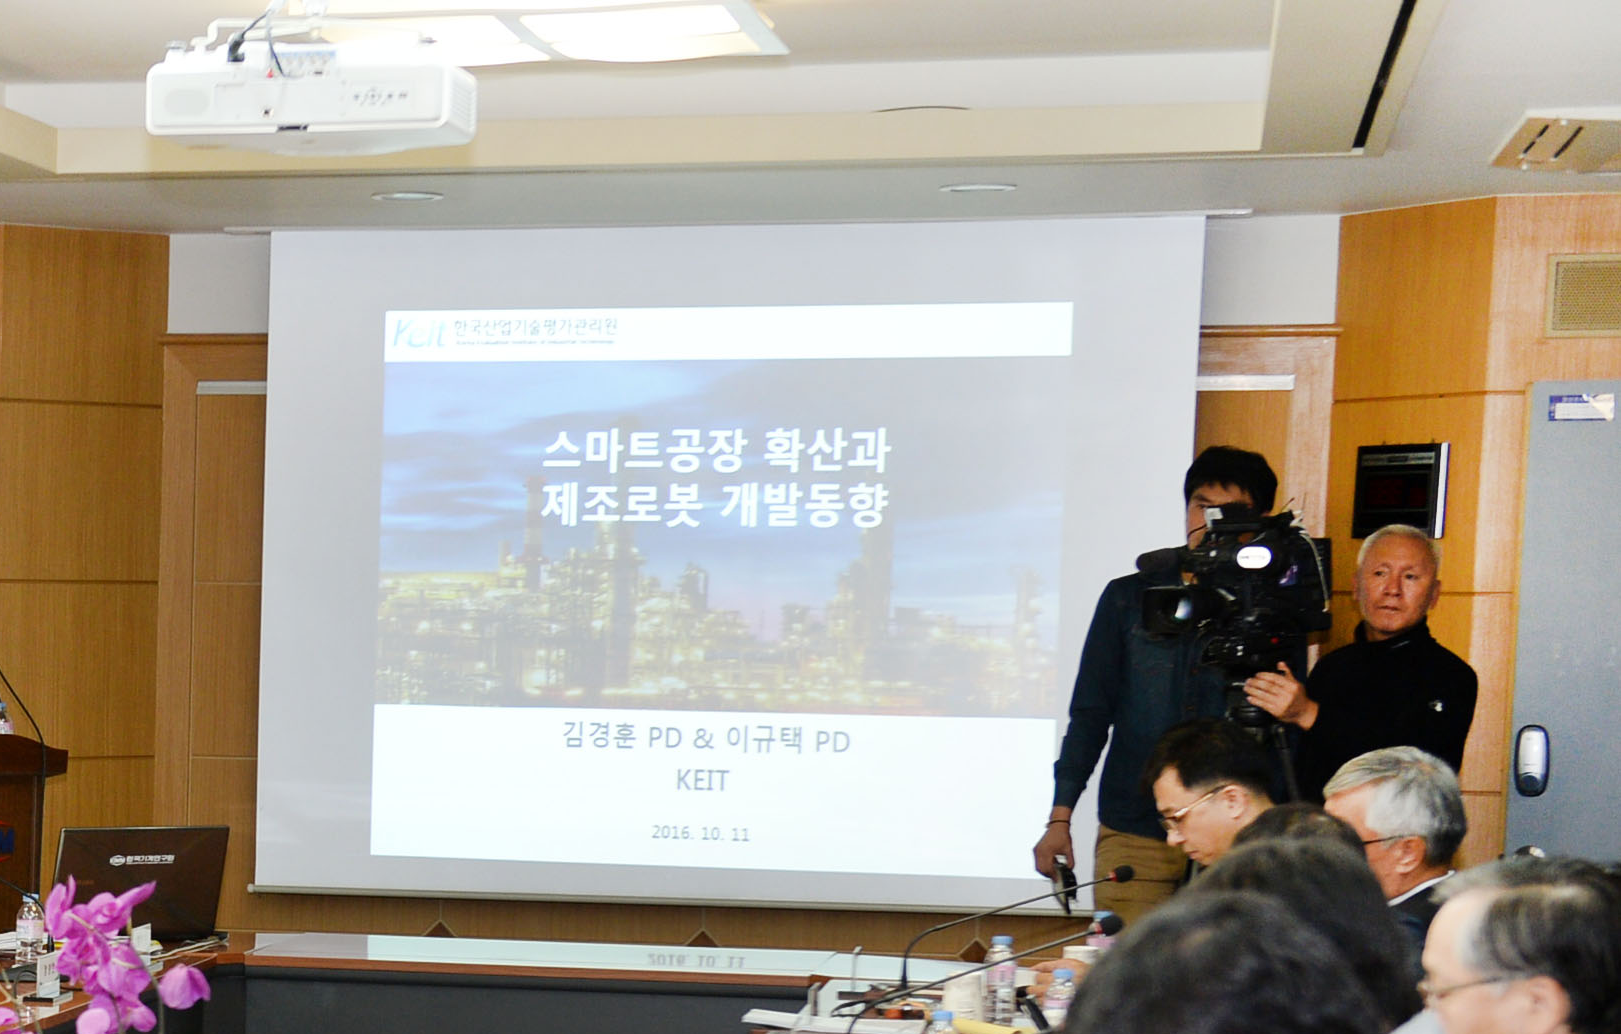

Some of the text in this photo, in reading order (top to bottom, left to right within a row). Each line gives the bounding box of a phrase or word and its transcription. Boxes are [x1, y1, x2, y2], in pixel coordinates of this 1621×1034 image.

[454, 317, 619, 337] 한국산업기술평가관리원
[541, 427, 892, 474] 스마트공장 확산과
[541, 481, 890, 529] 제조로봇 개발동향
[562, 721, 851, 754] 김경훈 PD & 이규택 PD
[676, 769, 731, 792] KEIT
[651, 824, 751, 842] 2016. 10. 11
